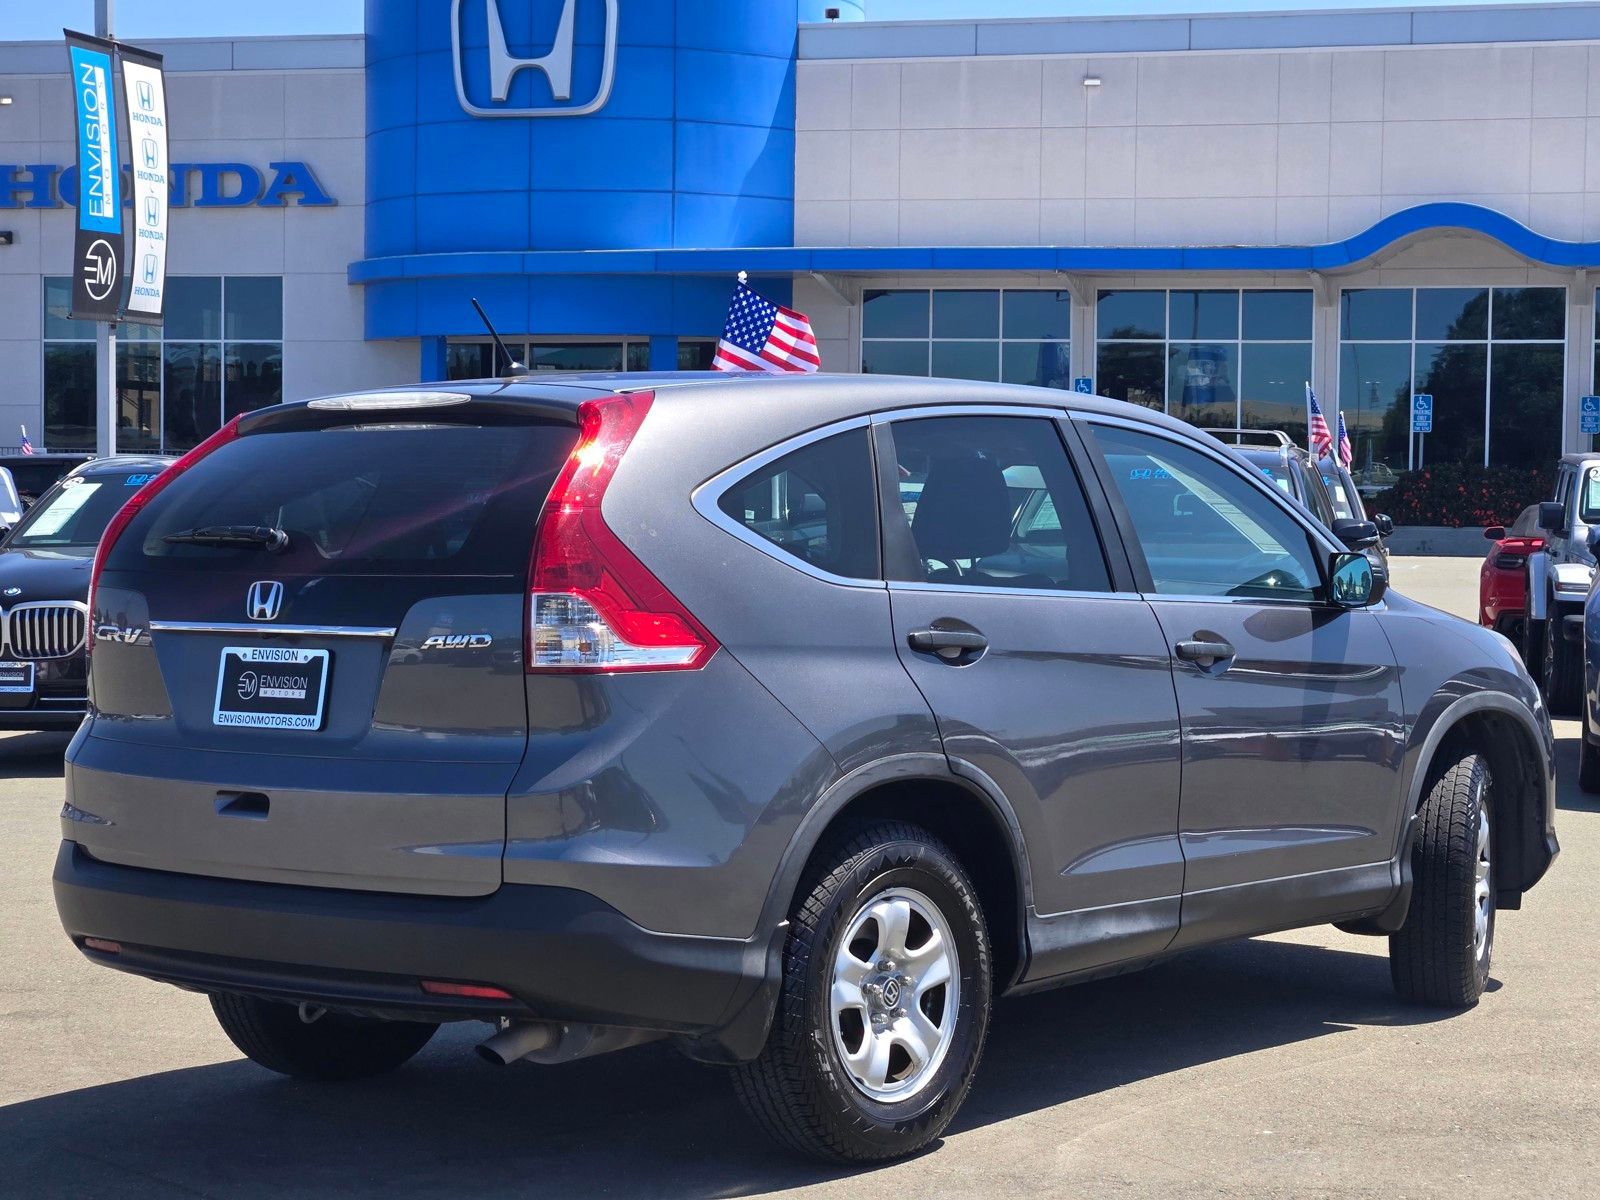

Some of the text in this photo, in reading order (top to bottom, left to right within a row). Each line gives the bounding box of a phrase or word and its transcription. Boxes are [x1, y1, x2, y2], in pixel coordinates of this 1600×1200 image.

[132, 112, 164, 127] HONDA
[80, 63, 105, 217] ENVISION
[98, 81, 113, 205] MOTORS
[0, 161, 335, 208] HDA
[137, 170, 165, 184] HONDA
[138, 228, 165, 240] HONDA
[134, 286, 161, 298] HONDA
[95, 625, 143, 643] CR-V
[420, 634, 493, 650] AWD
[251, 650, 298, 661] ENVISION
[259, 675, 309, 690] ENVISION
[263, 689, 303, 697] MOTORS
[218, 714, 316, 728] ENVISIONMOTORS.COM
